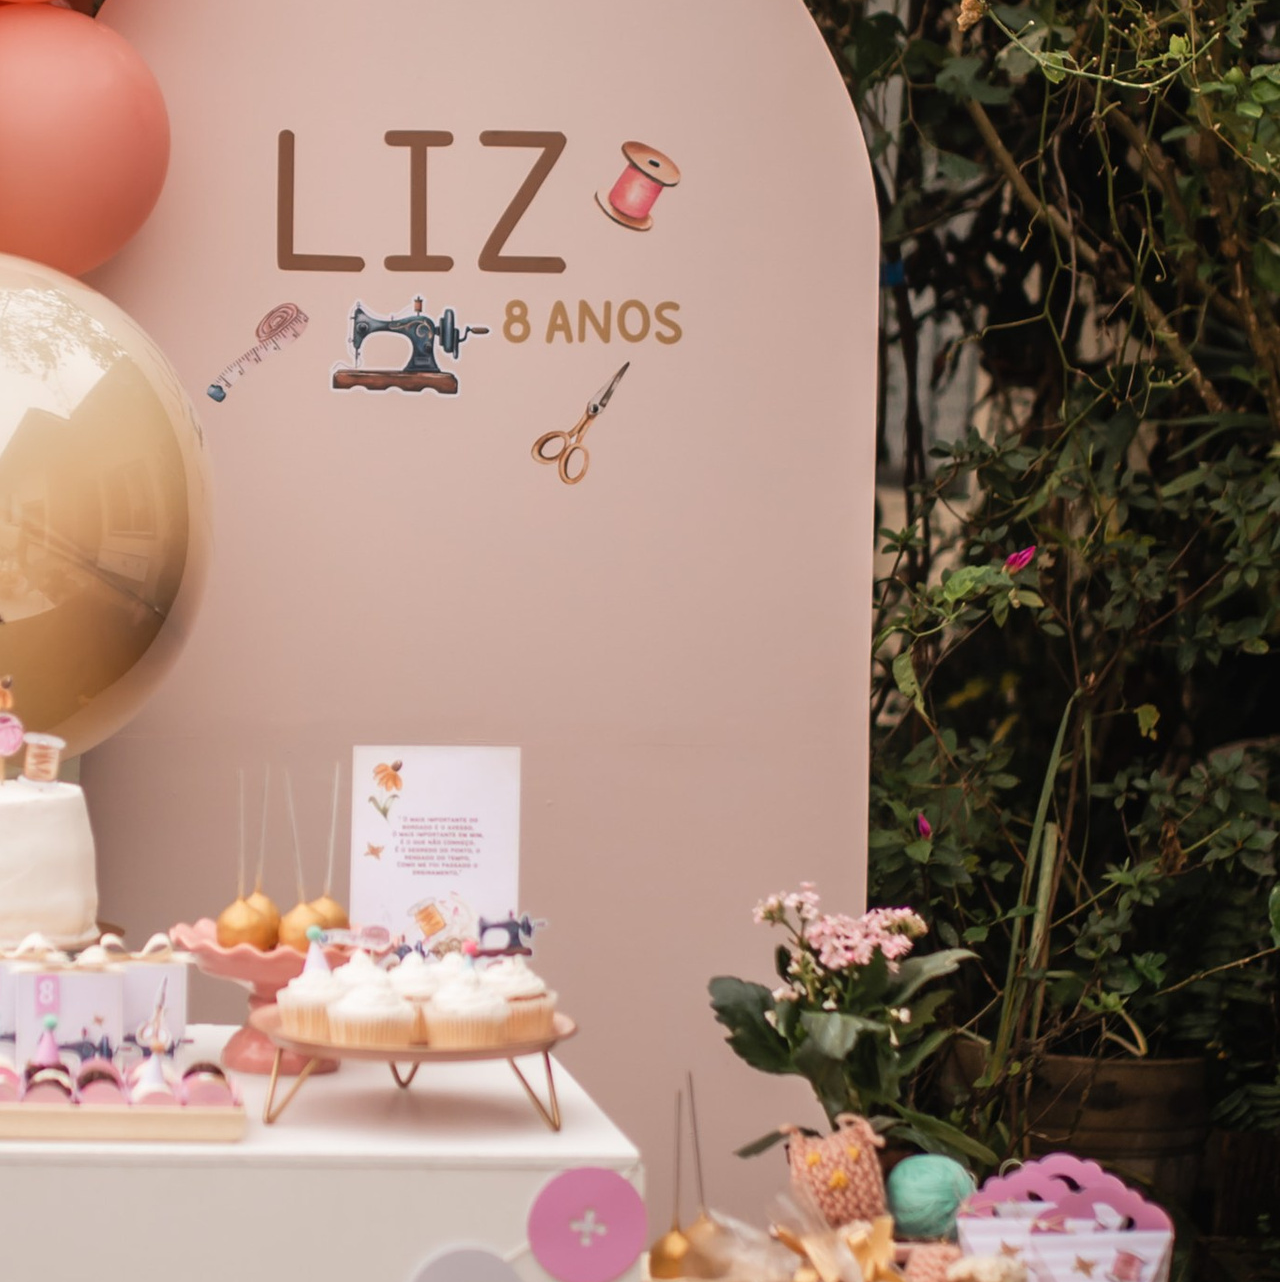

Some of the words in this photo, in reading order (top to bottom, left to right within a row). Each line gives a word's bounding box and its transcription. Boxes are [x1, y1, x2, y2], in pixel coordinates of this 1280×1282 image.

[277, 129, 567, 273] LIZ
[503, 299, 530, 343] 8
[546, 299, 682, 344] ANOS
[39, 979, 55, 1005] 8
